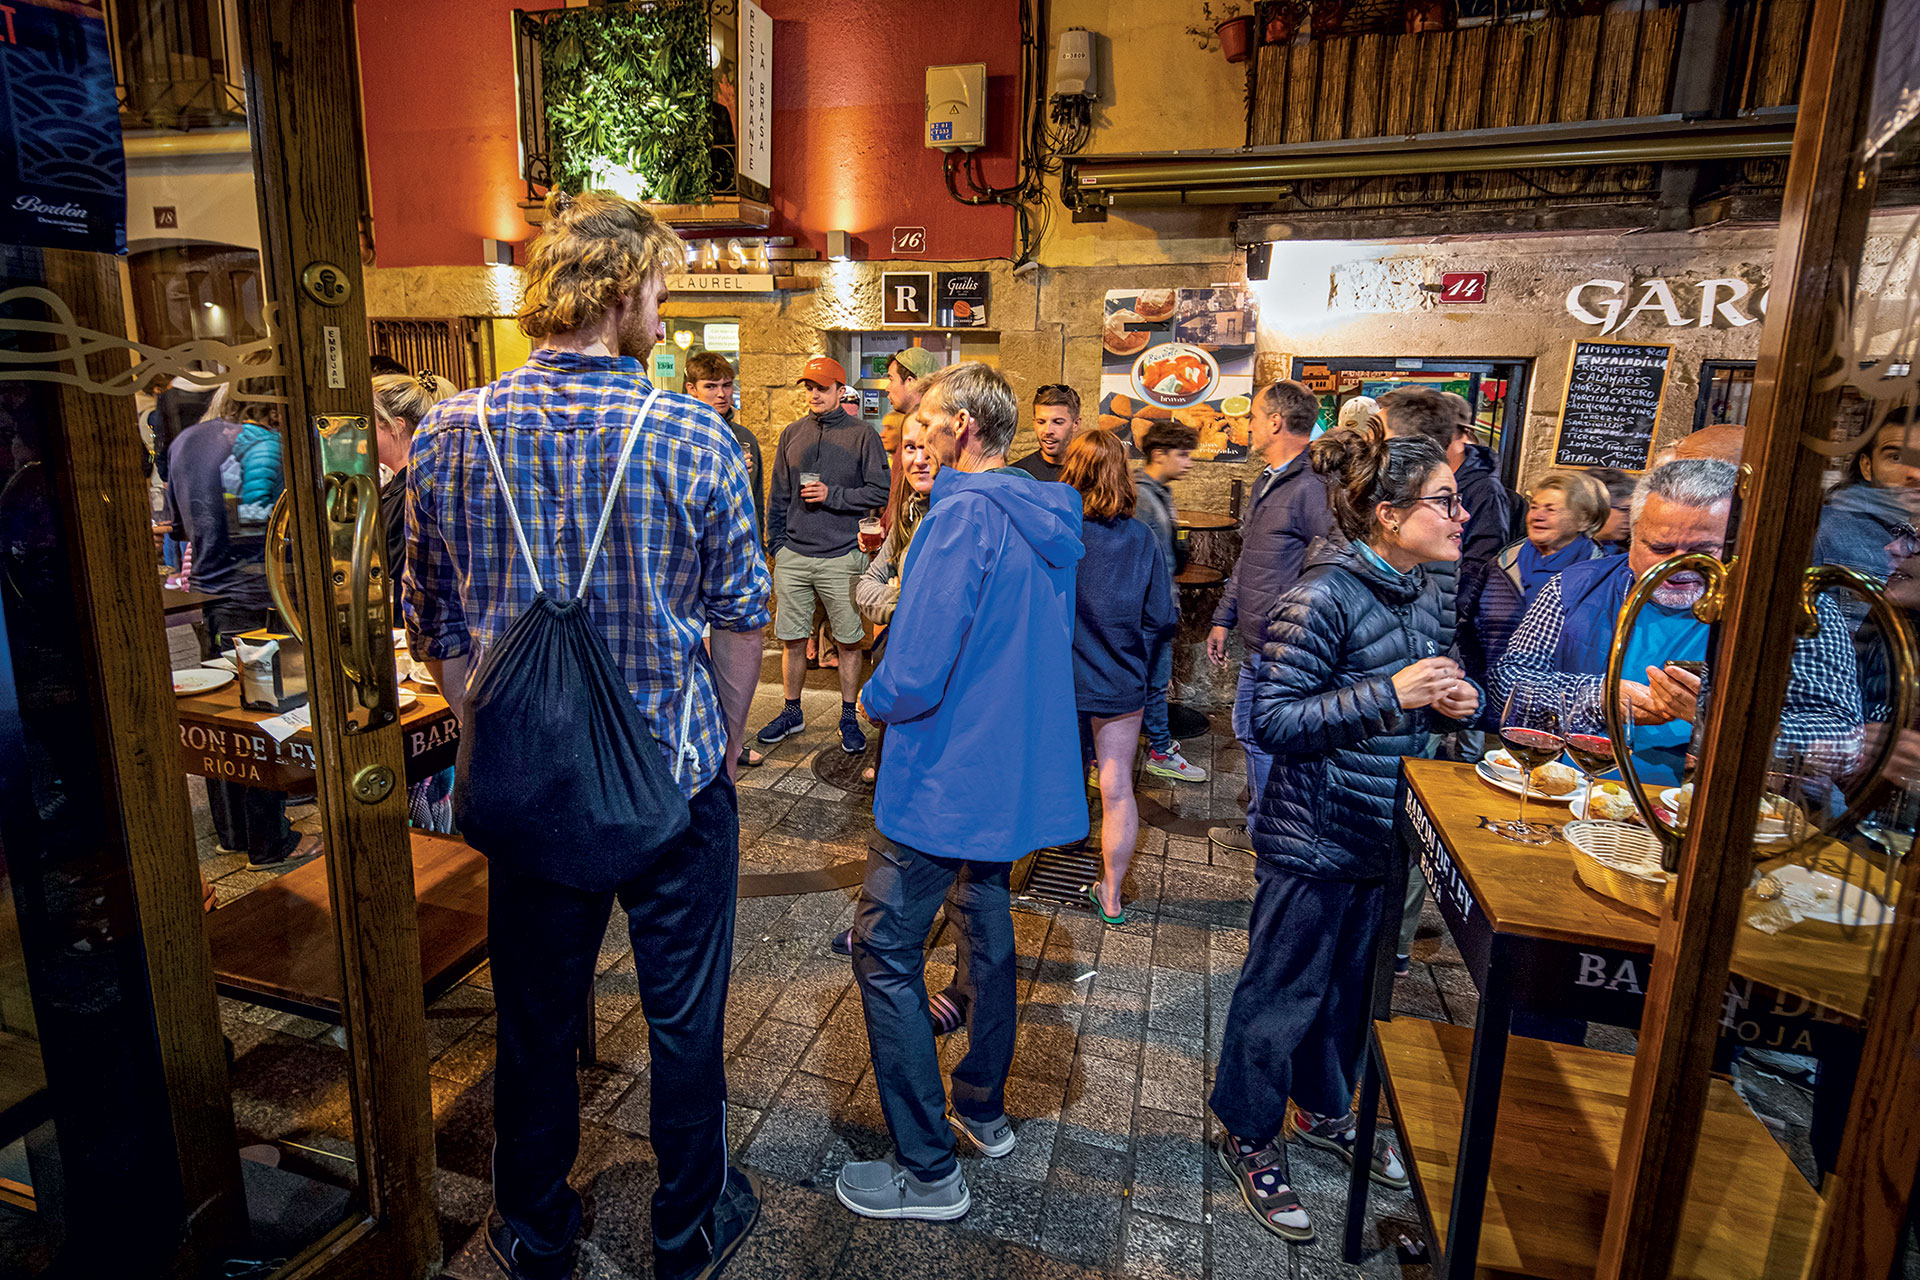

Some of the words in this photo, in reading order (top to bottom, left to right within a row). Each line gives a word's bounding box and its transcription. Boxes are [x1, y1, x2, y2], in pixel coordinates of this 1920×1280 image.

[759, 43, 766, 70] LA
[758, 82, 766, 153] BRASA
[12, 195, 88, 218] Bordón
[159, 211, 174, 224] 18
[898, 232, 922, 247] 16
[701, 238, 769, 271] ASA
[677, 277, 743, 290] LAUREL
[947, 277, 979, 296] Guilis
[1447, 277, 1479, 298] 14
[895, 285, 919, 312] R
[328, 330, 339, 385] EMPUJAR
[1574, 363, 1642, 375] CROQUETAS
[1570, 382, 1607, 394] CHORIZO
[1609, 387, 1655, 399] CASERO
[1576, 372, 1652, 388] CALAMARES
[1564, 432, 1604, 443] TIGRES
[233, 732, 268, 761] DE
[410, 718, 462, 758] BAR
[203, 756, 261, 781] RIOJA
[1405, 787, 1437, 859] BARON
[1420, 851, 1442, 904] RIOJA
